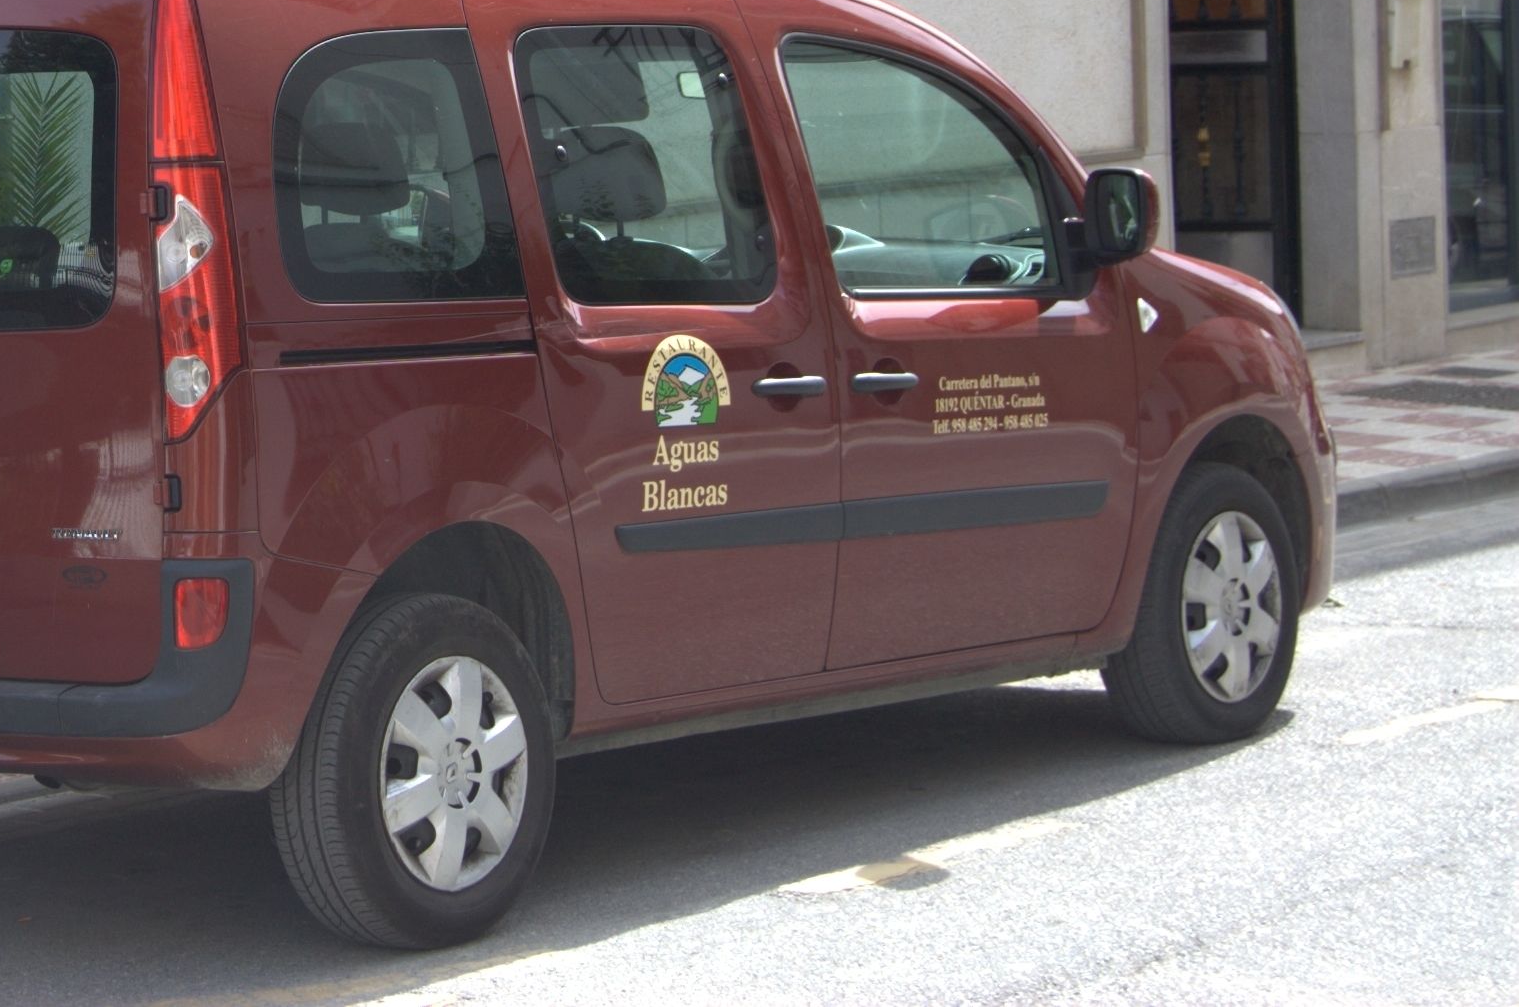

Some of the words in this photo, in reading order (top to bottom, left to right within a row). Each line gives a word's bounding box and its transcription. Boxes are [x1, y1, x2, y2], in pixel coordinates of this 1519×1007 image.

[644, 338, 729, 402] RESTAURANTE
[938, 376, 978, 391] Carretera
[980, 374, 992, 388] del
[935, 397, 958, 413] 18192
[960, 391, 1005, 414] QUÉNTAR
[1011, 392, 1046, 408] Granada
[652, 434, 720, 472] Aguas
[642, 479, 728, 512] Blancas
